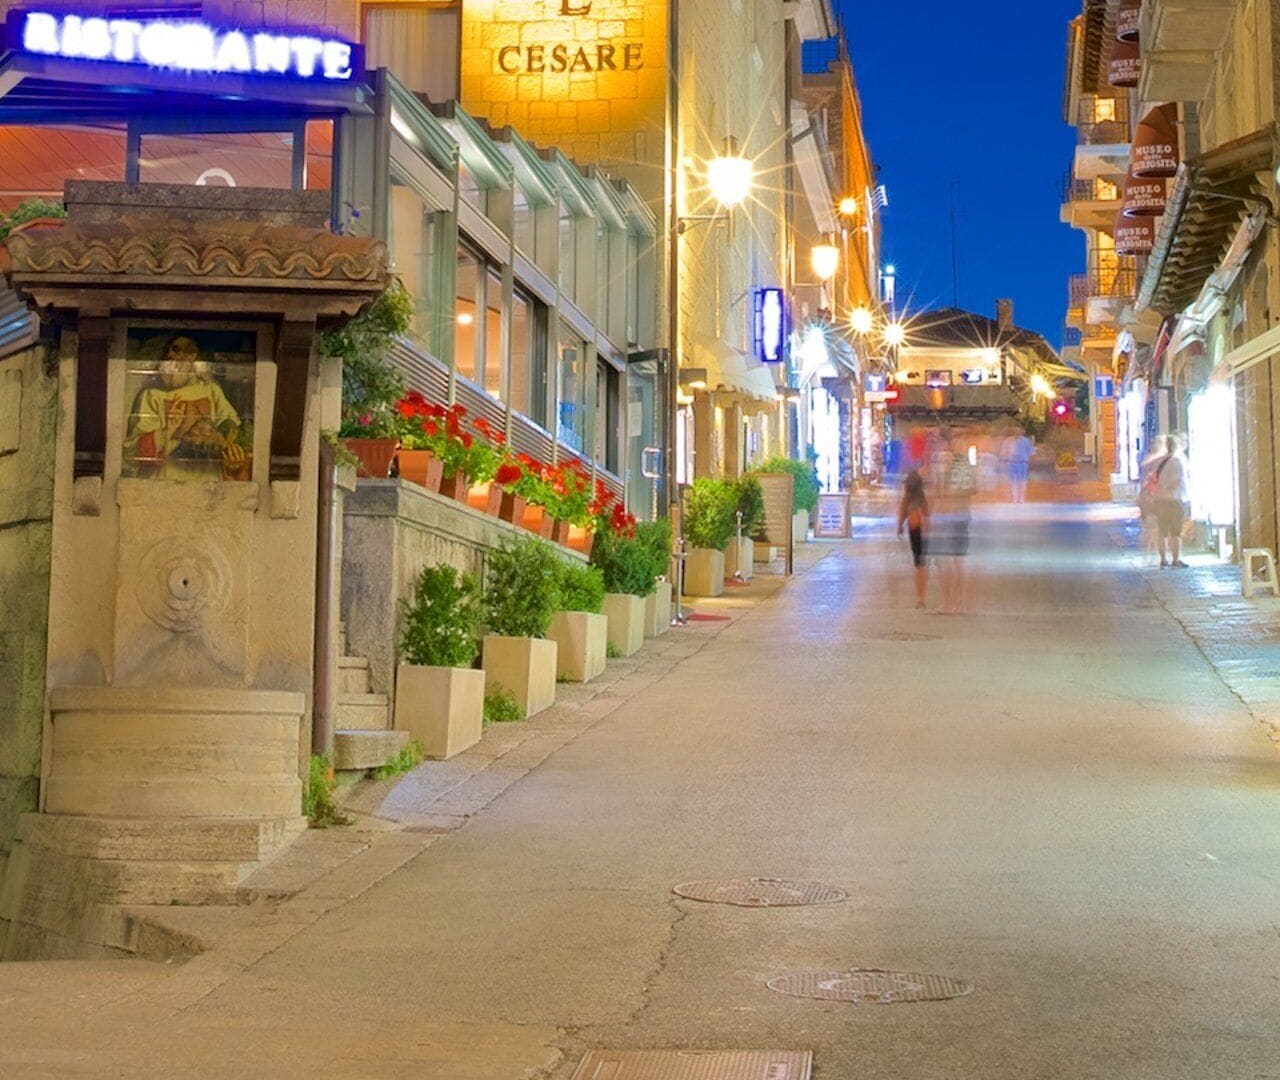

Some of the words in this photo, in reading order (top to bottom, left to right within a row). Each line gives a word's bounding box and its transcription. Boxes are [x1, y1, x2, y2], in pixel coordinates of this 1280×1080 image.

[23, 11, 353, 80] RISTORANTE
[497, 43, 644, 73] CESARE
[1135, 144, 1173, 155] MUSEO
[1126, 184, 1161, 196] MUSEO
[1117, 227, 1149, 237] MUSEO
